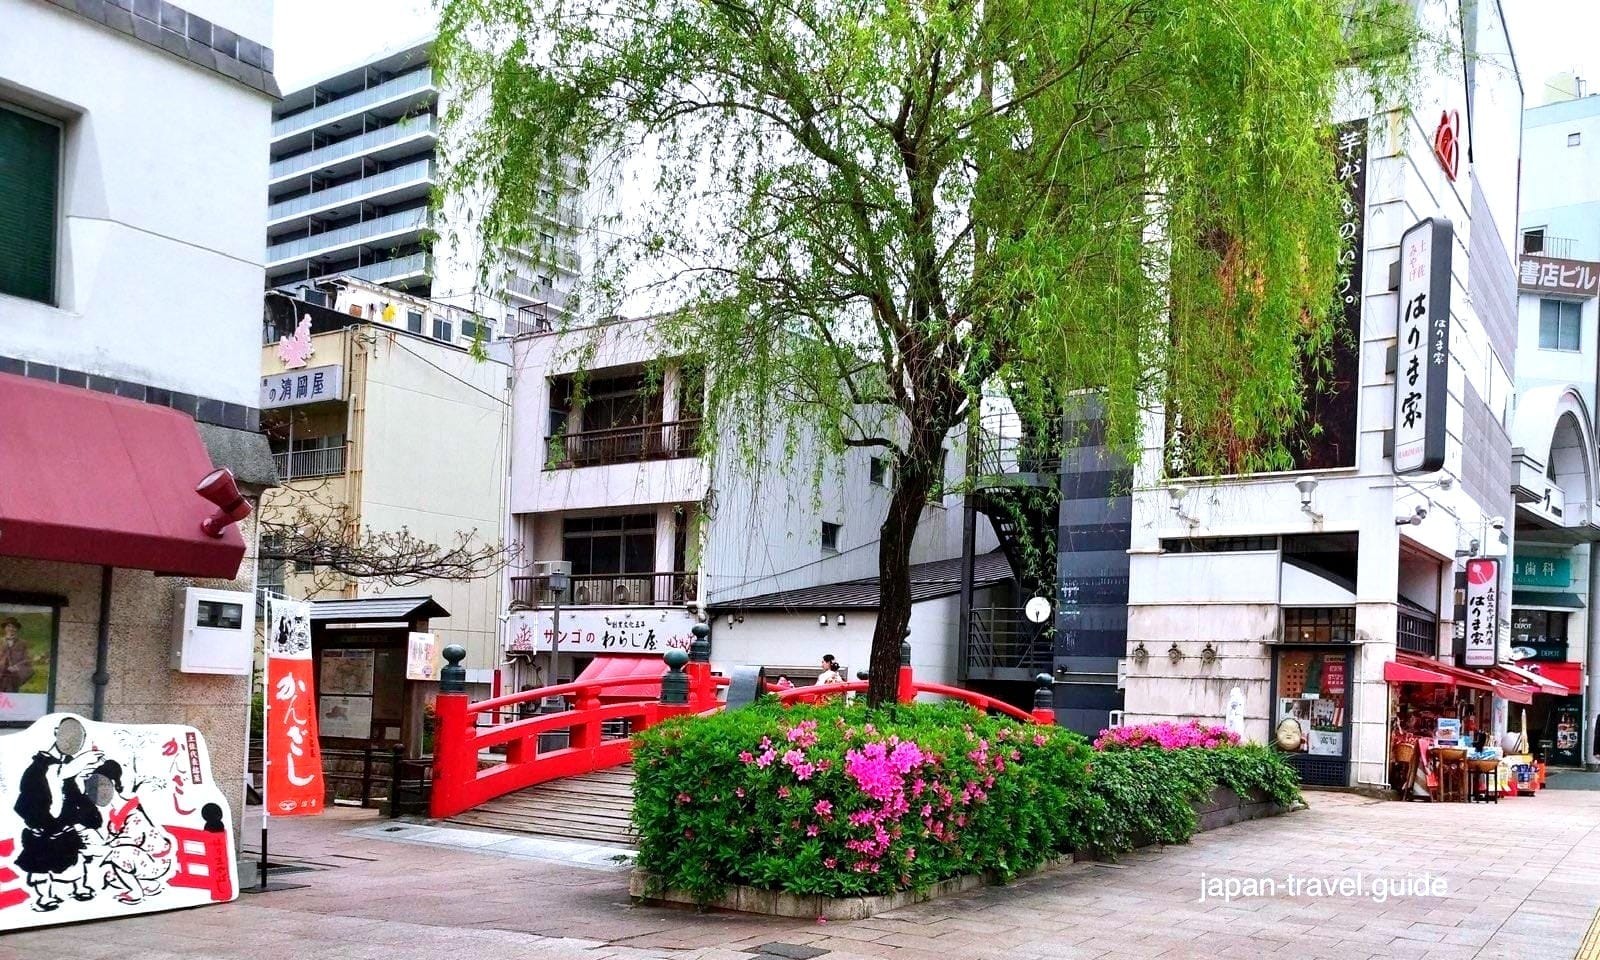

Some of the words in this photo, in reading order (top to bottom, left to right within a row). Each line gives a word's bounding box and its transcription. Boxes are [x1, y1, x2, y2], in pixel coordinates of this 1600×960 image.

[1520, 260, 1596, 289] 書店ビル
[1402, 293, 1426, 429] はりま家
[1434, 320, 1447, 364] はりま家
[269, 373, 324, 402] の清岡屋
[1470, 596, 1484, 645] はりま家
[276, 672, 314, 786] かんざし
[162, 737, 196, 815] かんざし
